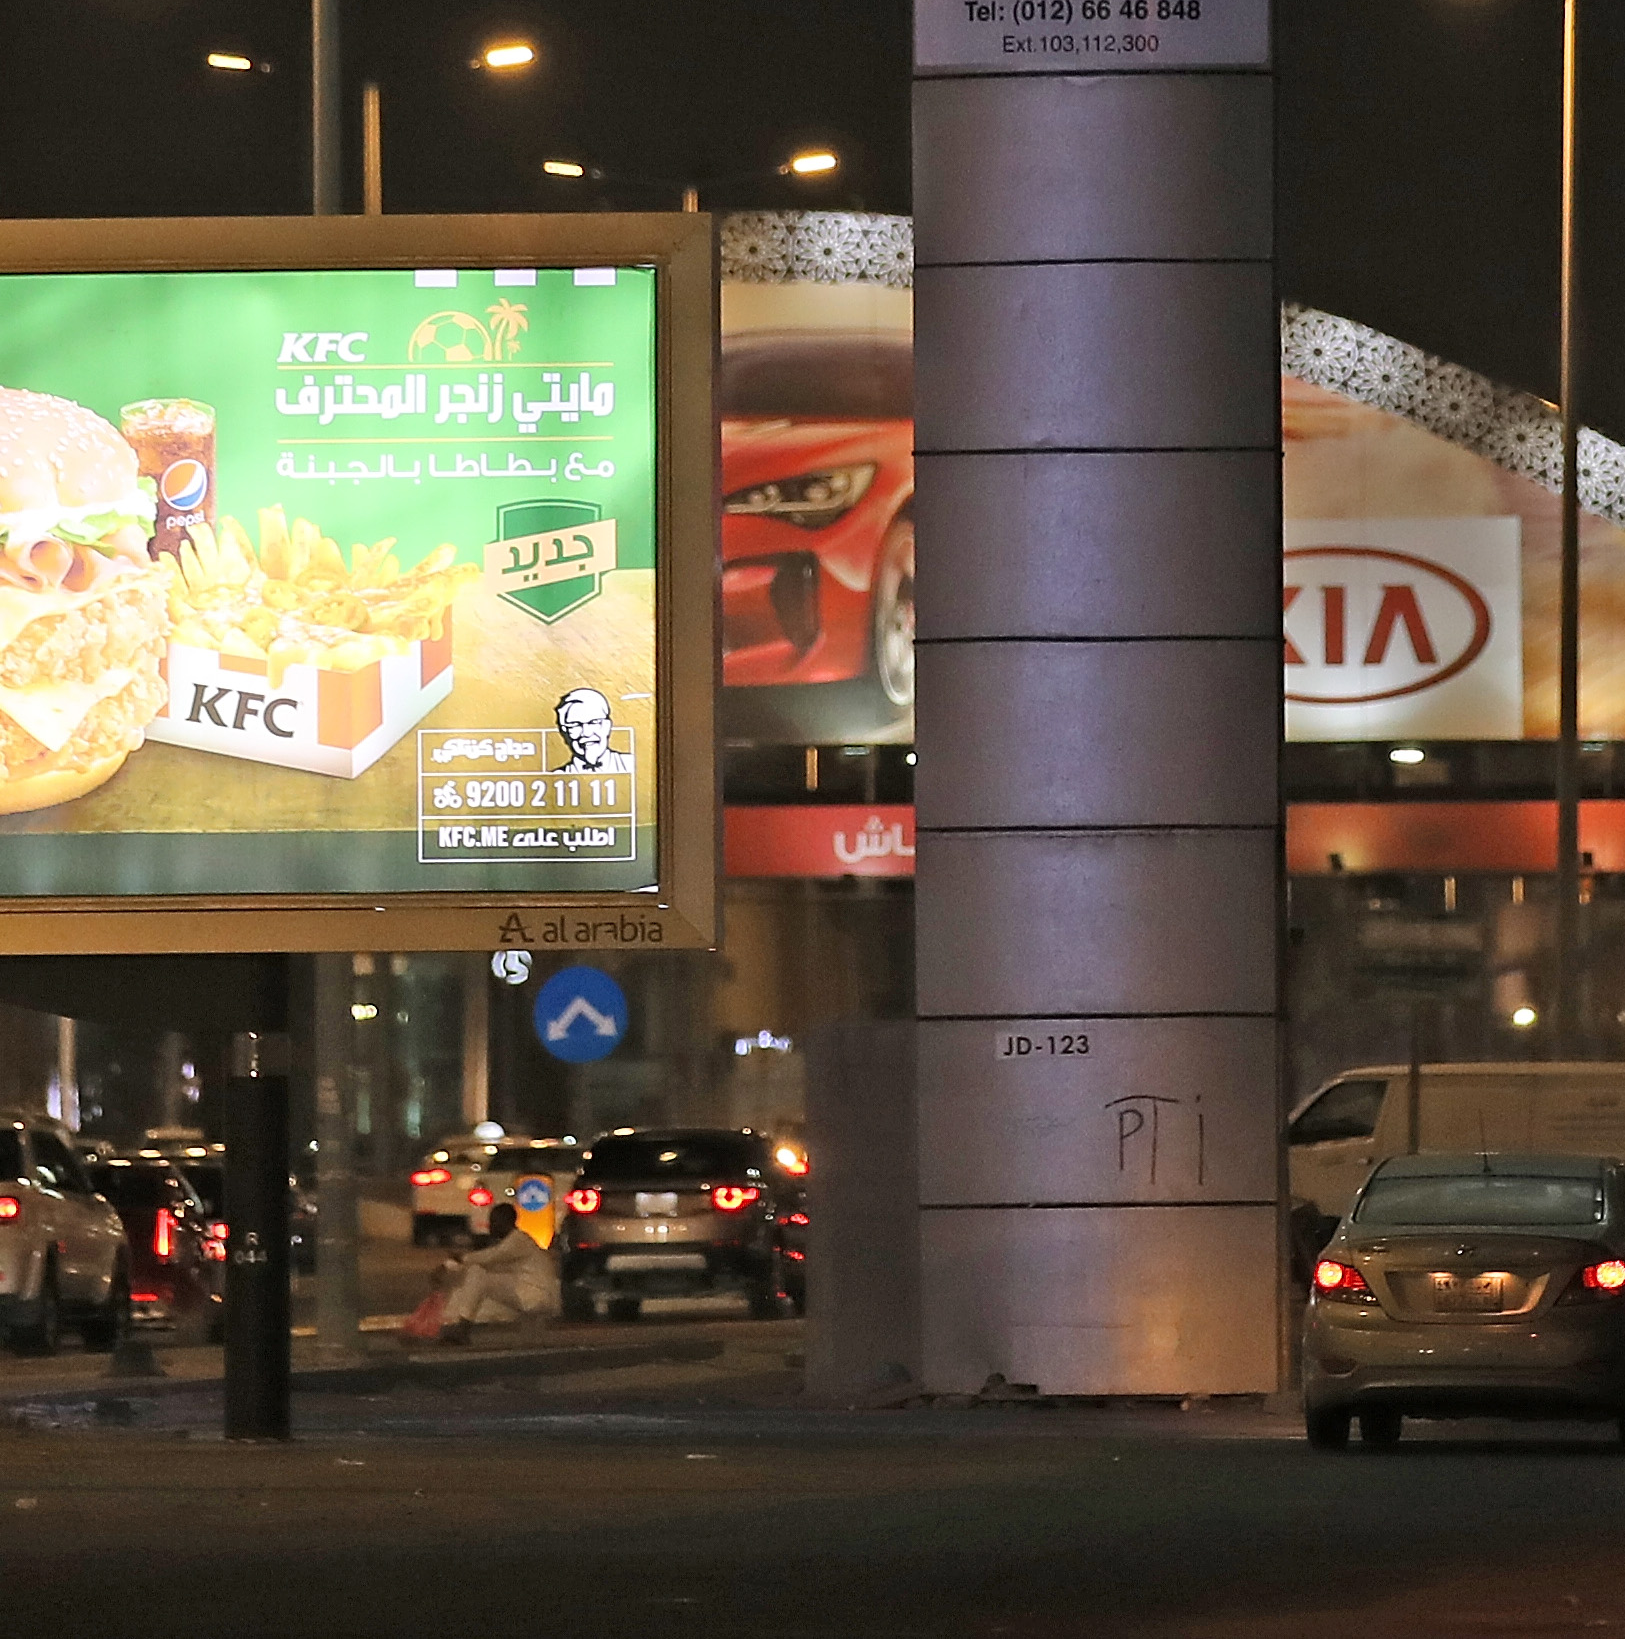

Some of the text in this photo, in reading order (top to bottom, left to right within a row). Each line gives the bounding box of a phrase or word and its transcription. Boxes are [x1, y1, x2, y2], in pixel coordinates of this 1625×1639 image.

[964, 0, 1202, 24] Tel: (012) 66 46 848
[276, 331, 369, 363] KFC
[275, 372, 616, 434] مايتي زنجر المحترف
[276, 451, 616, 485] مع بطاطا بالجبنة
[165, 509, 205, 530] pepsi
[502, 535, 595, 583] جديد
[1284, 583, 1438, 665] IA
[185, 682, 299, 739] KFC
[466, 778, 616, 807] 9200 2 11 11
[439, 826, 615, 852] اطلب على KFC.ME
[833, 815, 916, 864] اش
[542, 914, 569, 943] al
[575, 914, 663, 943] arabia
[1003, 1034, 1090, 1056] JD-123
